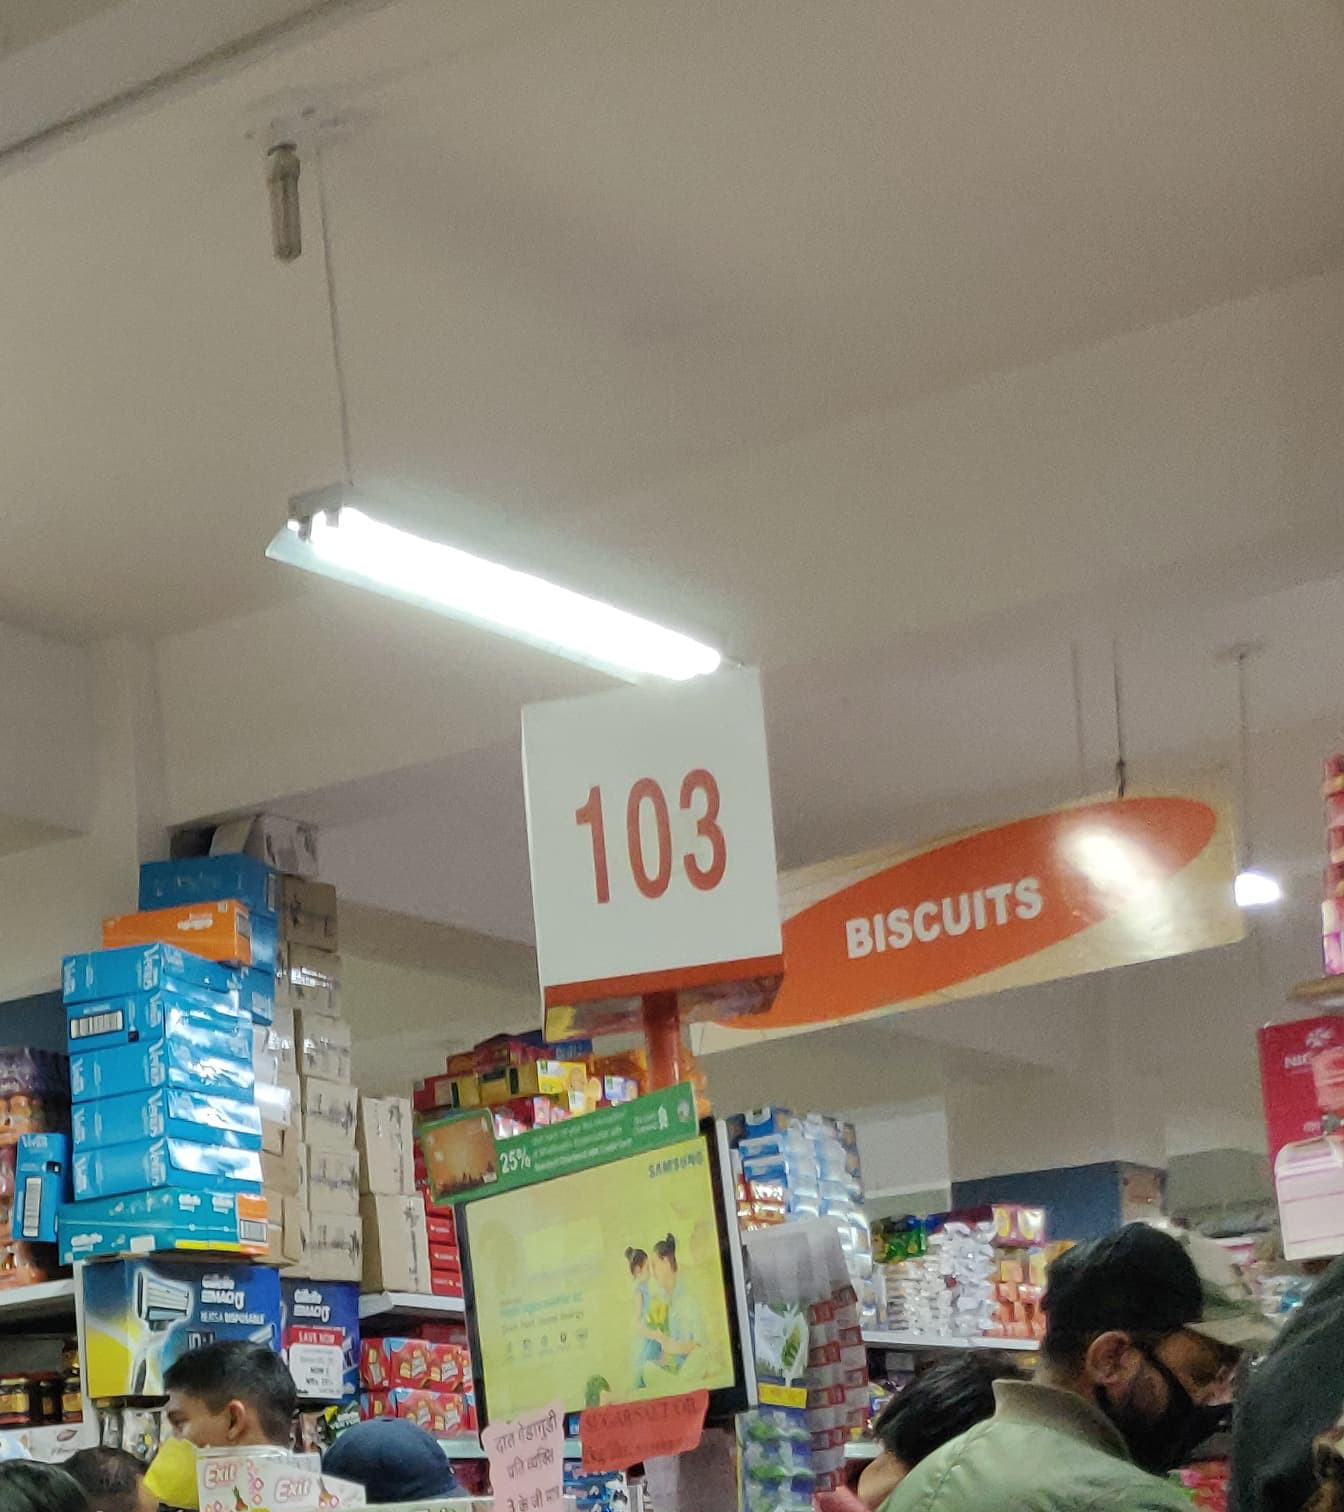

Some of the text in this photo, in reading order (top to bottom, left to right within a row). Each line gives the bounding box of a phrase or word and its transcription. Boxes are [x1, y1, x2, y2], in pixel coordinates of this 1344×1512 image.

[575, 767, 727, 904] 103
[846, 877, 1043, 960] BISCUITS
[499, 1148, 532, 1174] 25%
[203, 1461, 238, 1489] Exit
[275, 1478, 311, 1503] Exit
